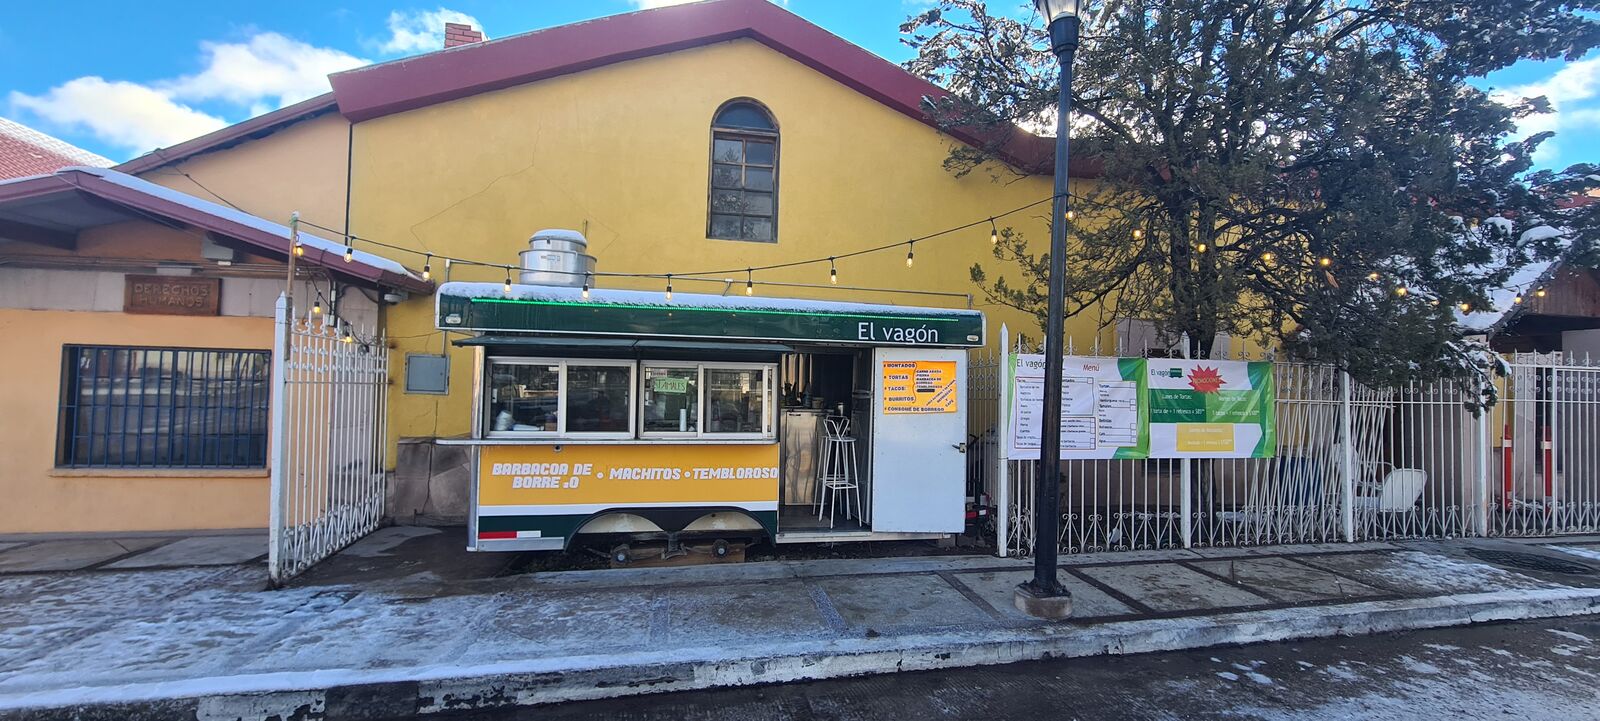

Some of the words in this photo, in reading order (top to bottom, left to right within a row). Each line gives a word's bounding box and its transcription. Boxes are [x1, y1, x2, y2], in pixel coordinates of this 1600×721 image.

[135, 283, 209, 298] DERECHOS
[139, 294, 204, 308] HUMANOS
[858, 322, 875, 340] El
[882, 324, 939, 345] vagón
[1017, 359, 1023, 367] El
[492, 463, 569, 476] BARBACOA
[573, 463, 593, 476] DE
[609, 467, 681, 480] MACHITOS
[693, 467, 778, 480] TEMBLOROSO
